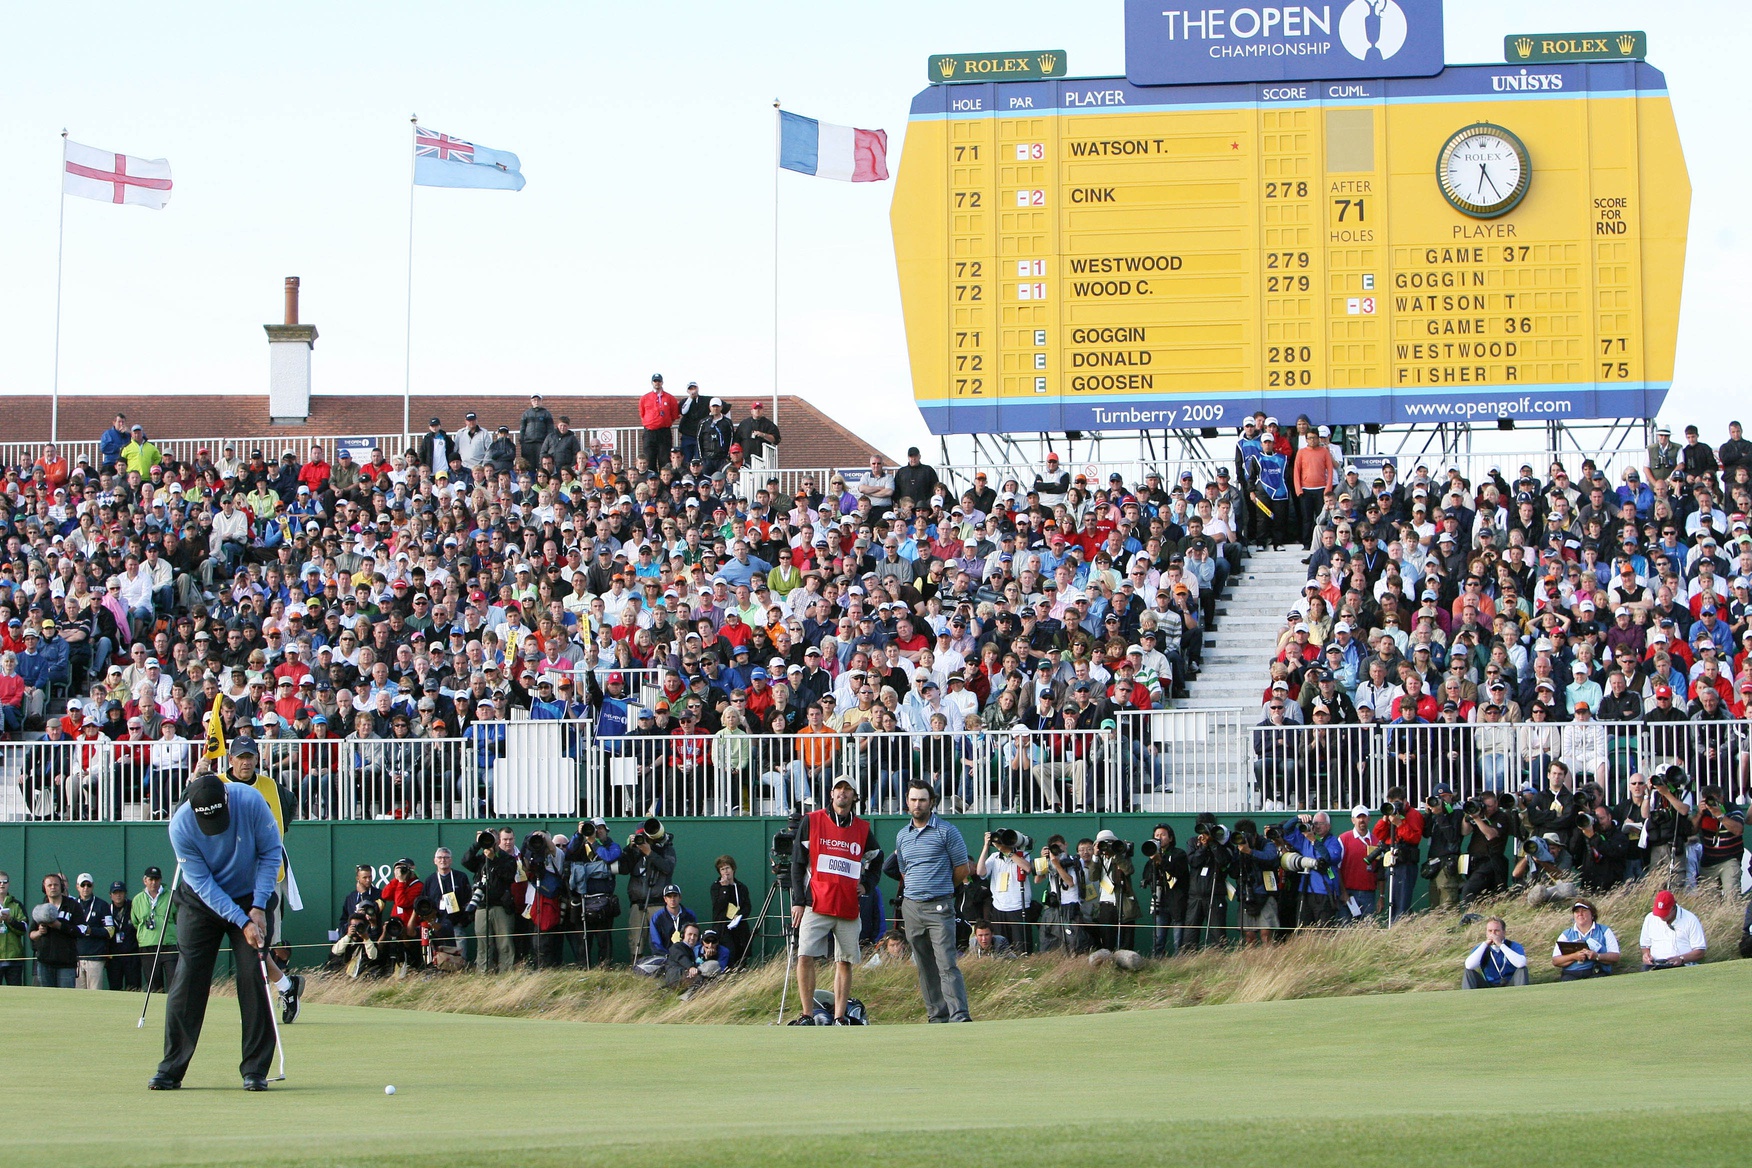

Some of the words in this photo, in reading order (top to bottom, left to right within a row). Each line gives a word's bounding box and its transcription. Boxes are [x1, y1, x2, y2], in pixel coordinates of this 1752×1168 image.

[1162, 10, 1225, 40] THE
[1230, 6, 1330, 38] OPEN
[1210, 42, 1330, 58] CHAMPIONSHIP
[1542, 39, 1608, 53] ROLEX
[965, 59, 1030, 73] ROLEX
[1066, 90, 1125, 106] PLAYER
[1263, 88, 1306, 100] SCORE
[1329, 86, 1370, 98] CUML.
[953, 99, 981, 110] HOLE
[1010, 97, 1034, 109] PAR
[955, 146, 977, 161] 71
[1071, 141, 1148, 155] WATSON
[1153, 140, 1169, 153] T.
[1267, 182, 1307, 197] 278
[1331, 181, 1371, 193] AFTER
[956, 192, 980, 207] 72
[1072, 189, 1115, 202] CINK
[1595, 198, 1626, 208] SCORE
[1335, 199, 1363, 221] 71
[1602, 210, 1620, 219] FOR
[1454, 225, 1516, 238] PLAYER
[1597, 222, 1626, 234] RND
[1330, 230, 1374, 243] HOLES
[1269, 253, 1308, 268] 279
[1427, 249, 1482, 263] GAME
[1504, 247, 1529, 261] 37
[956, 262, 981, 277] 72
[1071, 256, 1182, 273] WESTWOOD
[1074, 281, 1131, 296] WOOD
[1137, 280, 1154, 294] C.
[1269, 276, 1309, 291] 279
[1364, 275, 1373, 289] E
[1396, 273, 1483, 288] GOGGIN
[956, 285, 981, 300] 72
[1396, 296, 1484, 311] WATSON
[1506, 295, 1514, 308] T
[1428, 320, 1484, 334] GAME
[1506, 318, 1531, 333] 36
[957, 332, 979, 347] 71
[1036, 331, 1044, 345] E
[1073, 328, 1144, 343] GOGGIN
[1397, 343, 1516, 358] WESTWOOD
[1602, 339, 1625, 354] 71
[1036, 354, 1045, 368] E
[1073, 351, 1151, 367] DONALD
[1270, 347, 1310, 362] 280
[957, 356, 981, 370] 72
[1602, 363, 1628, 378] 75
[1270, 370, 1310, 386] 280
[1400, 368, 1485, 382] FISHER
[1507, 367, 1516, 380] R
[957, 379, 982, 394] 72
[1036, 378, 1045, 392] E
[1072, 375, 1152, 390] GOOSEN
[1405, 397, 1571, 418] www.opengolf.com
[1092, 407, 1177, 426] Turnberry
[1183, 405, 1223, 421] 2009
[507, 631, 516, 655] STAND
[194, 803, 223, 813] ADAMS
[831, 840, 850, 849] OPEN
[828, 859, 852, 873] GOGGIN
